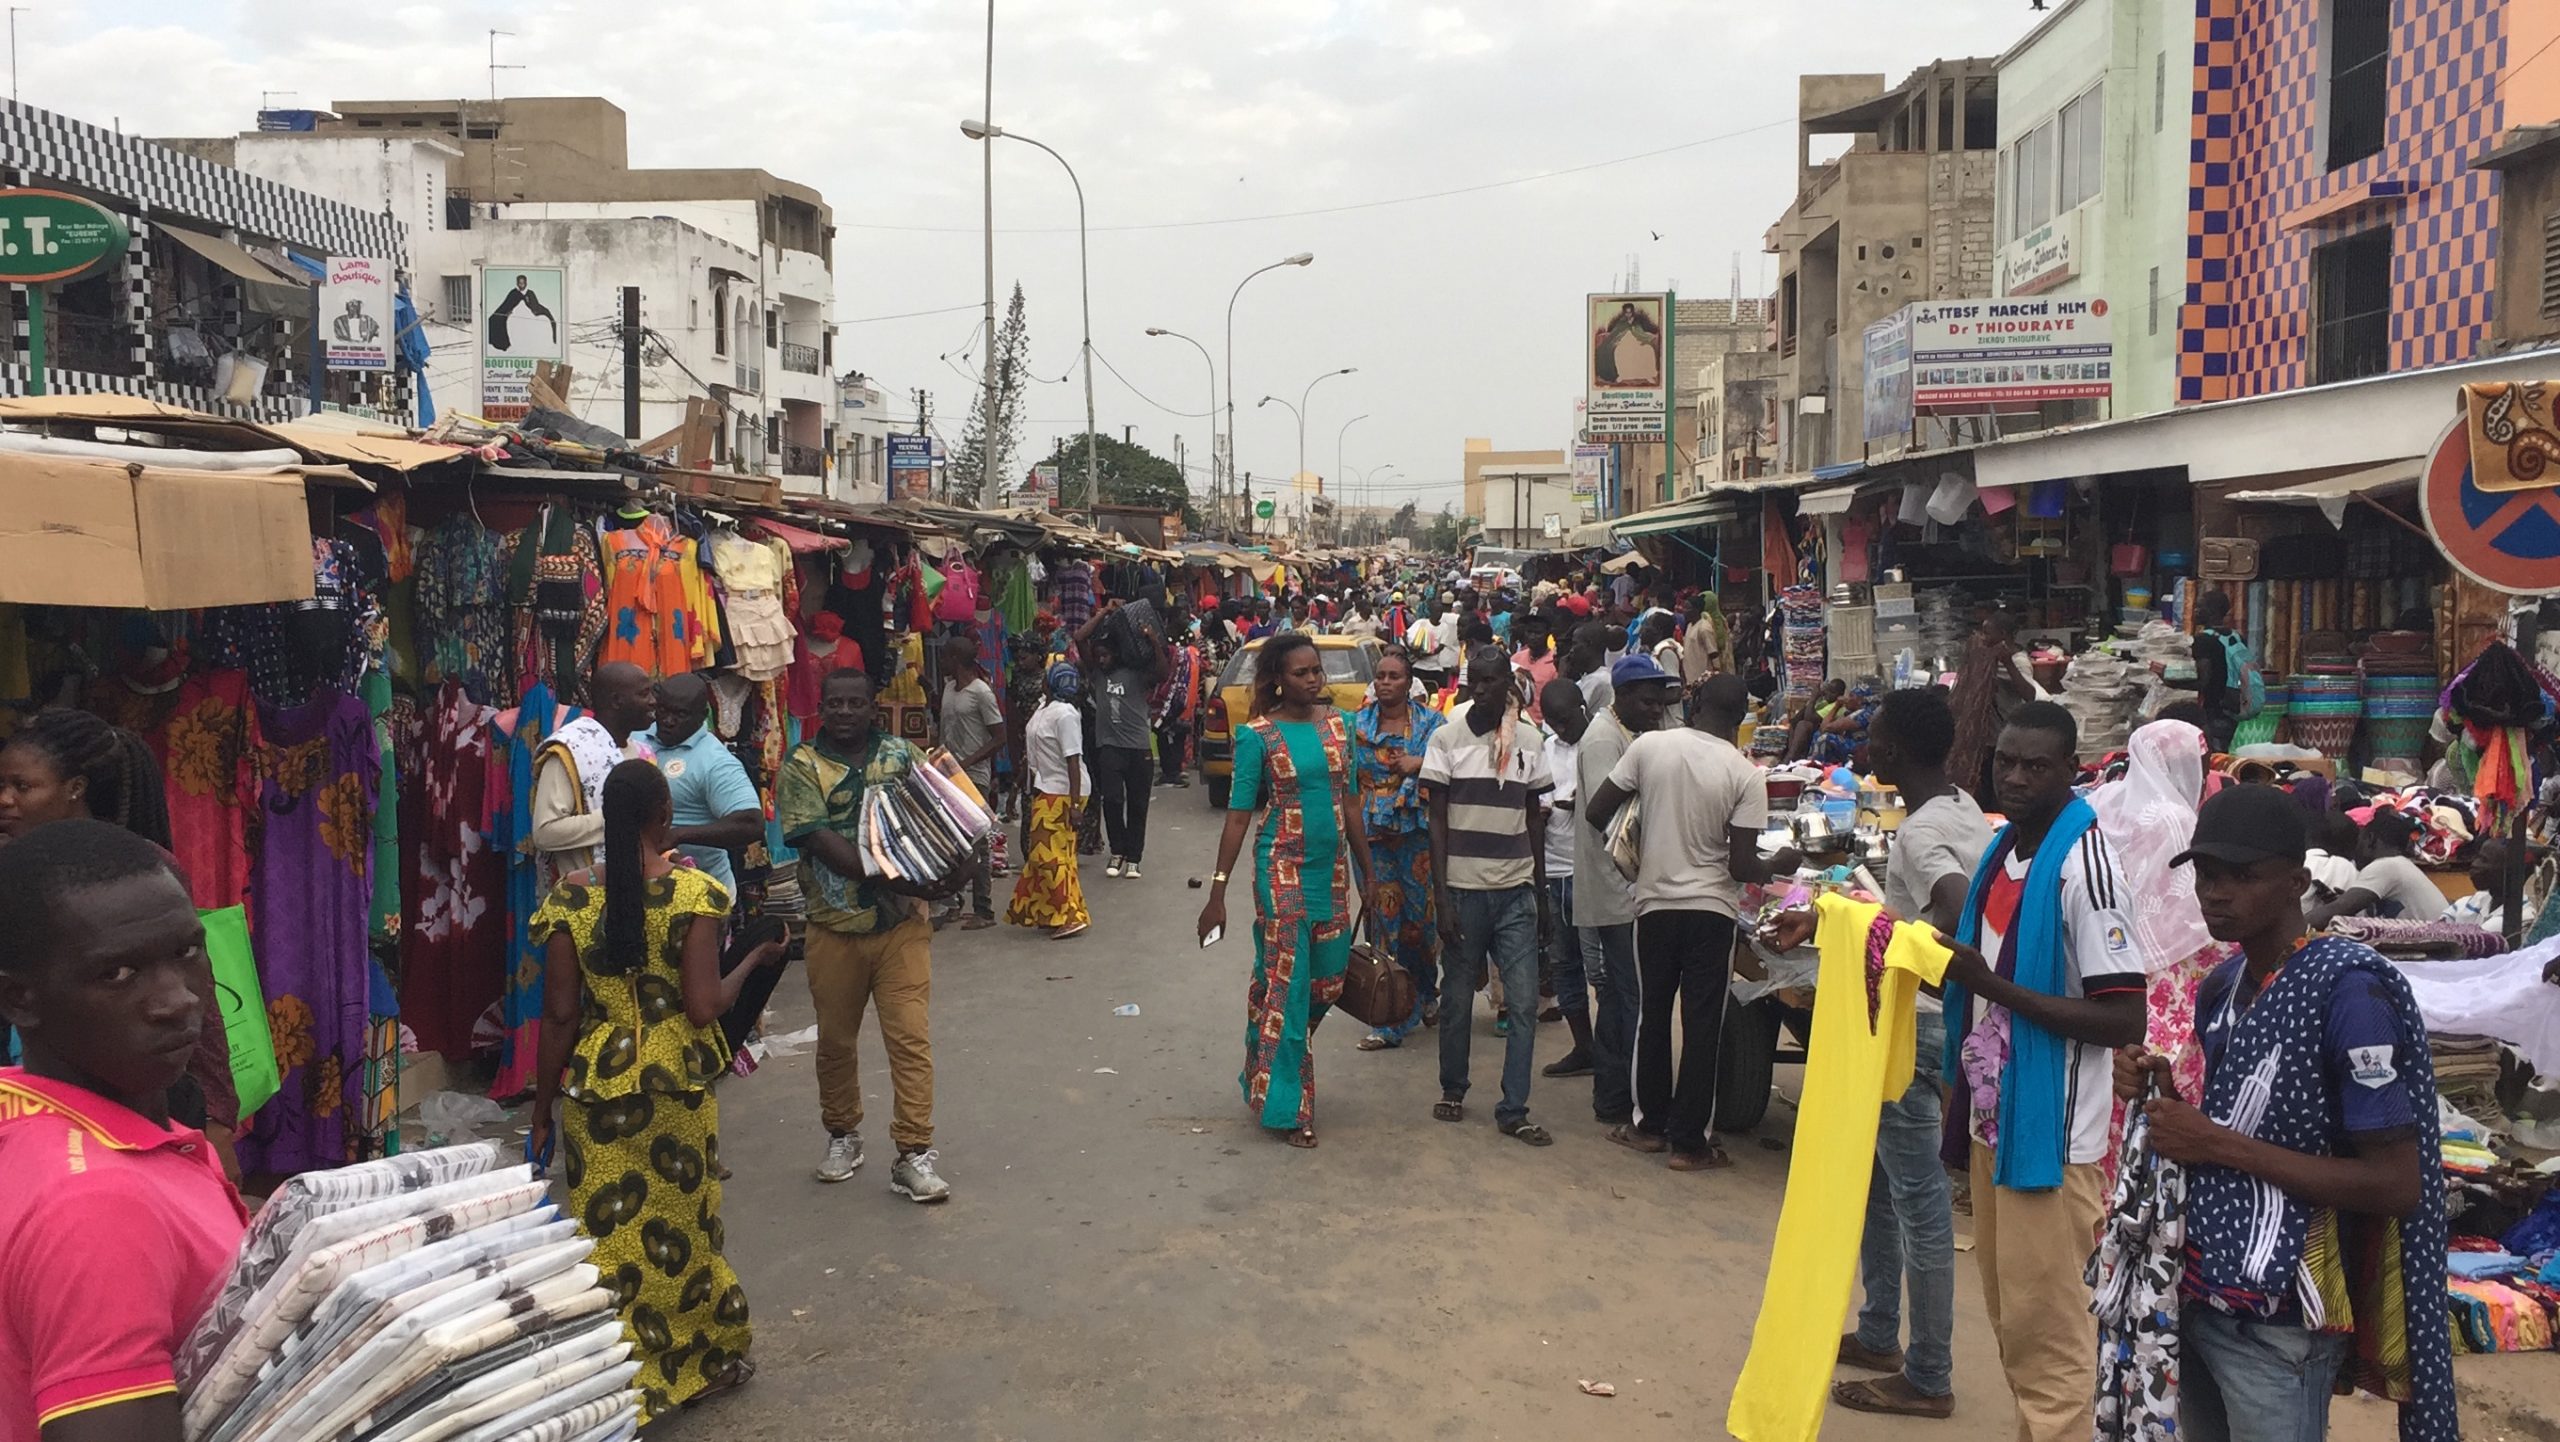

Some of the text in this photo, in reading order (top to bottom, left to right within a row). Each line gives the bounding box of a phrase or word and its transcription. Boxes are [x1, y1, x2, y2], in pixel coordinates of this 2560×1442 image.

[338, 261, 370, 271] Lama
[332, 272, 381, 285] Boutique
[1938, 300, 2087, 319] TTBSF MARCHÉ HLM
[1949, 319, 2075, 335] Dr THIOURAYE
[485, 359, 534, 368] BOUTIQUE
